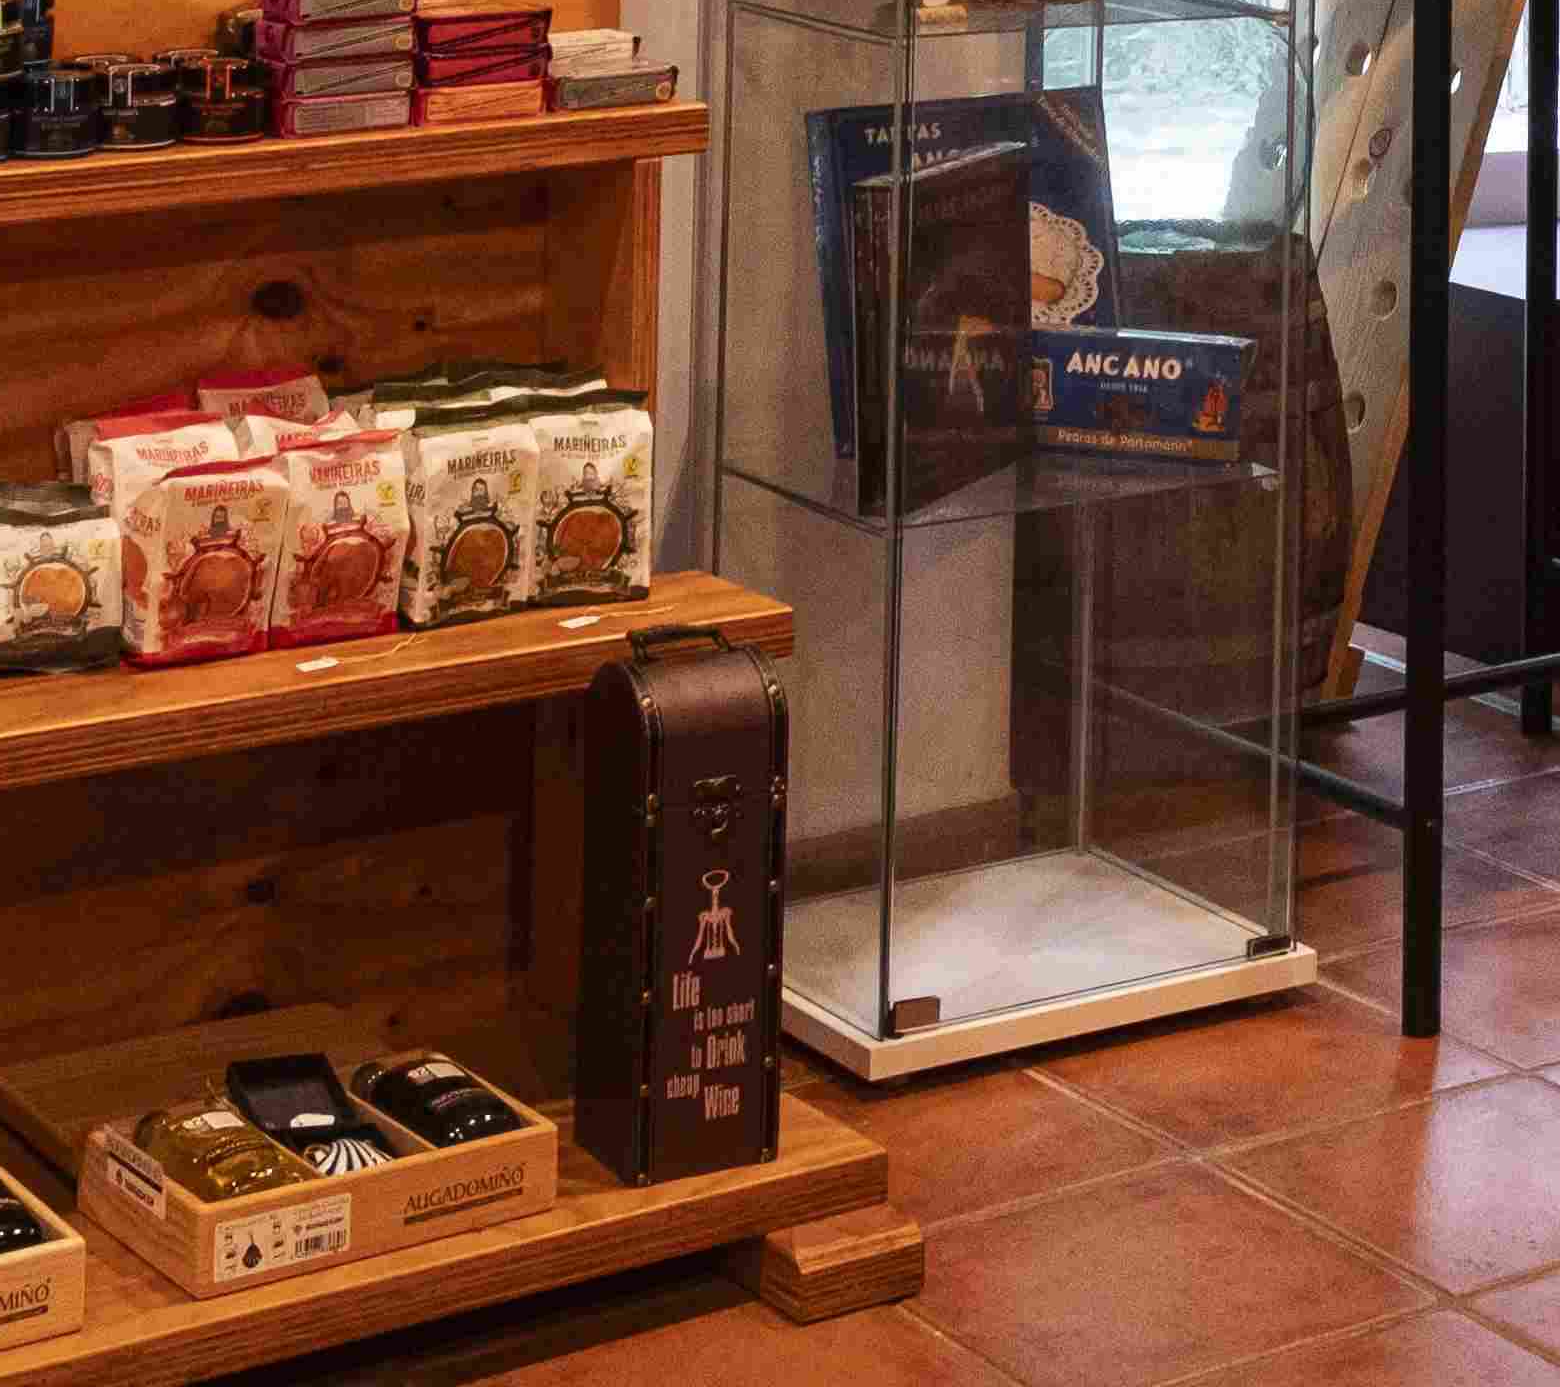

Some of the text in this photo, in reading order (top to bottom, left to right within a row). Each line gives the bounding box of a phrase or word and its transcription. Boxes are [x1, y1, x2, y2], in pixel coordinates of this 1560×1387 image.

[1065, 350, 1182, 380] ANCANO
[554, 433, 626, 454] MARIÑEIRAS
[447, 449, 517, 476] MARIÑEIRAS
[672, 971, 701, 1011] Life
[706, 1028, 746, 1069] Drink
[666, 1074, 700, 1100] cheap
[703, 1084, 740, 1120] Wine
[402, 1164, 525, 1214] AUGADOMIÑO
